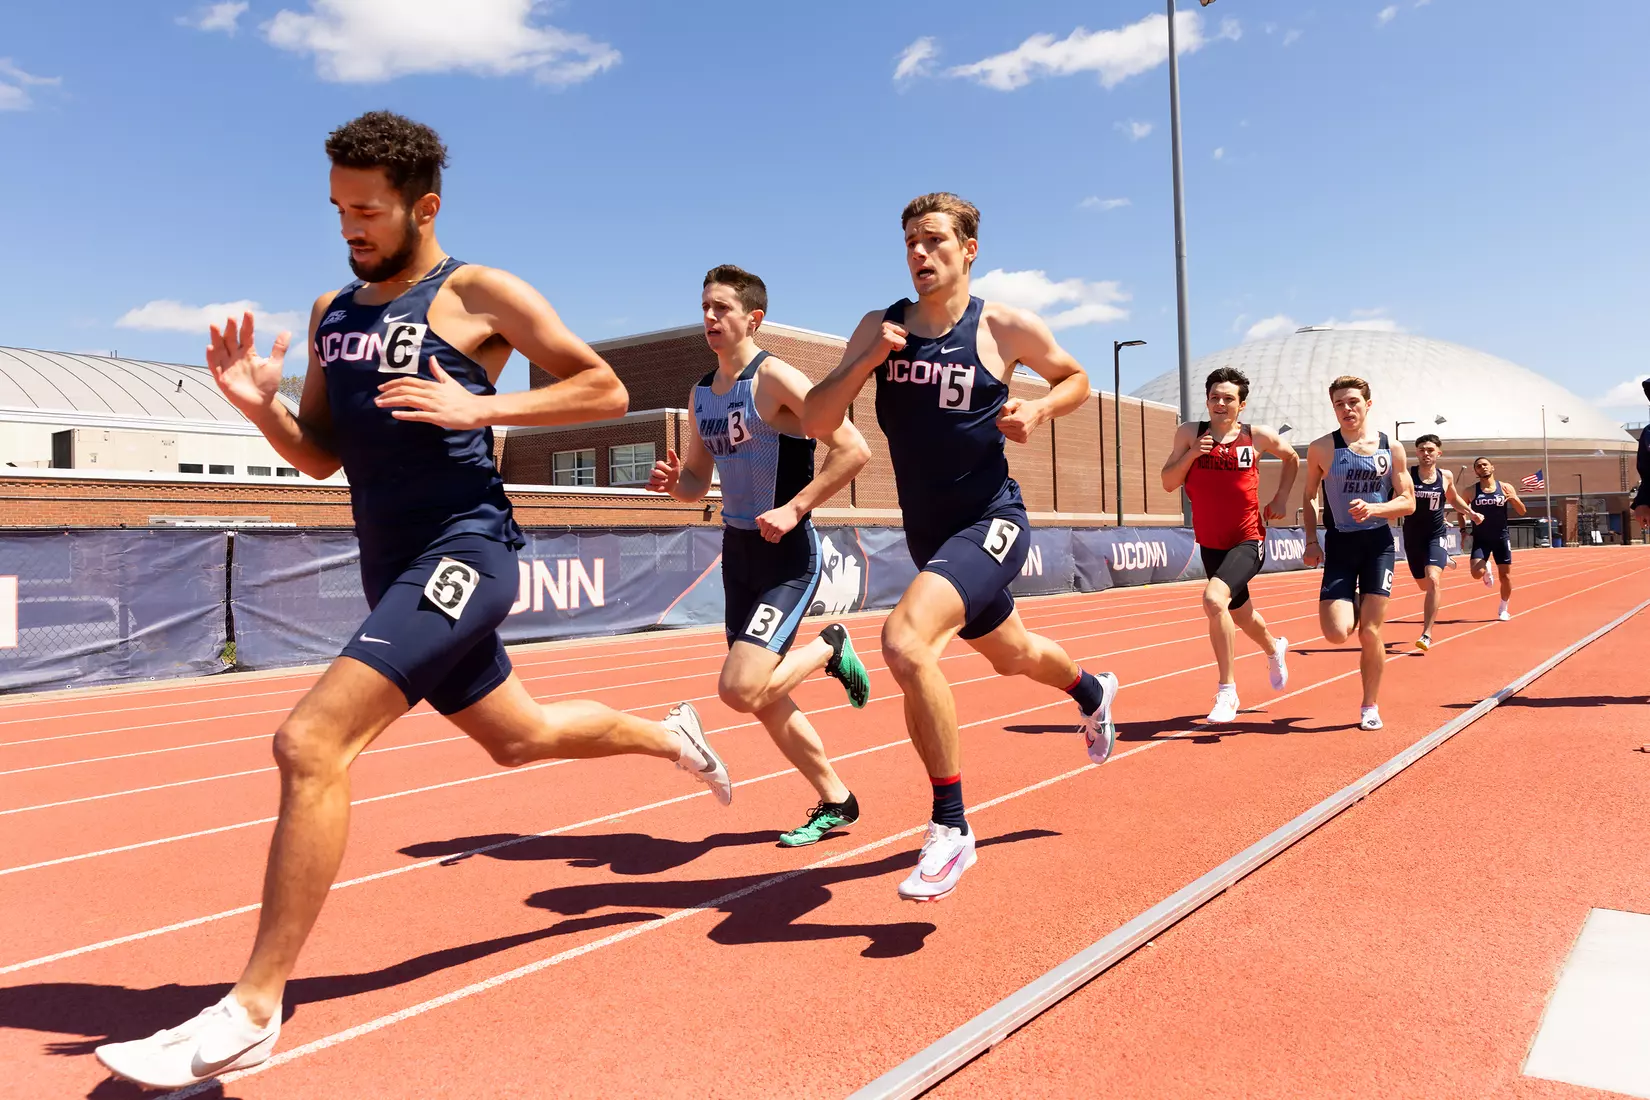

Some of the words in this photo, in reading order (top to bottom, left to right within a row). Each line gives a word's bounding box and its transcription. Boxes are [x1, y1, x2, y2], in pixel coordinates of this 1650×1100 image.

[314, 331, 383, 367] UCON
[386, 325, 417, 369] 6
[946, 370, 966, 407] 5
[731, 411, 745, 443] 3
[1240, 447, 1252, 467] 4
[1377, 456, 1388, 475] 9
[1343, 481, 1382, 493] ISLAND
[1497, 496, 1504, 506] 2
[1432, 497, 1439, 510] 7
[1475, 498, 1498, 507] UCON
[989, 522, 1015, 555] 5
[1268, 538, 1306, 561] UCONN
[1111, 541, 1168, 571] UCONN
[432, 564, 471, 610] 6
[751, 607, 776, 637] 3
